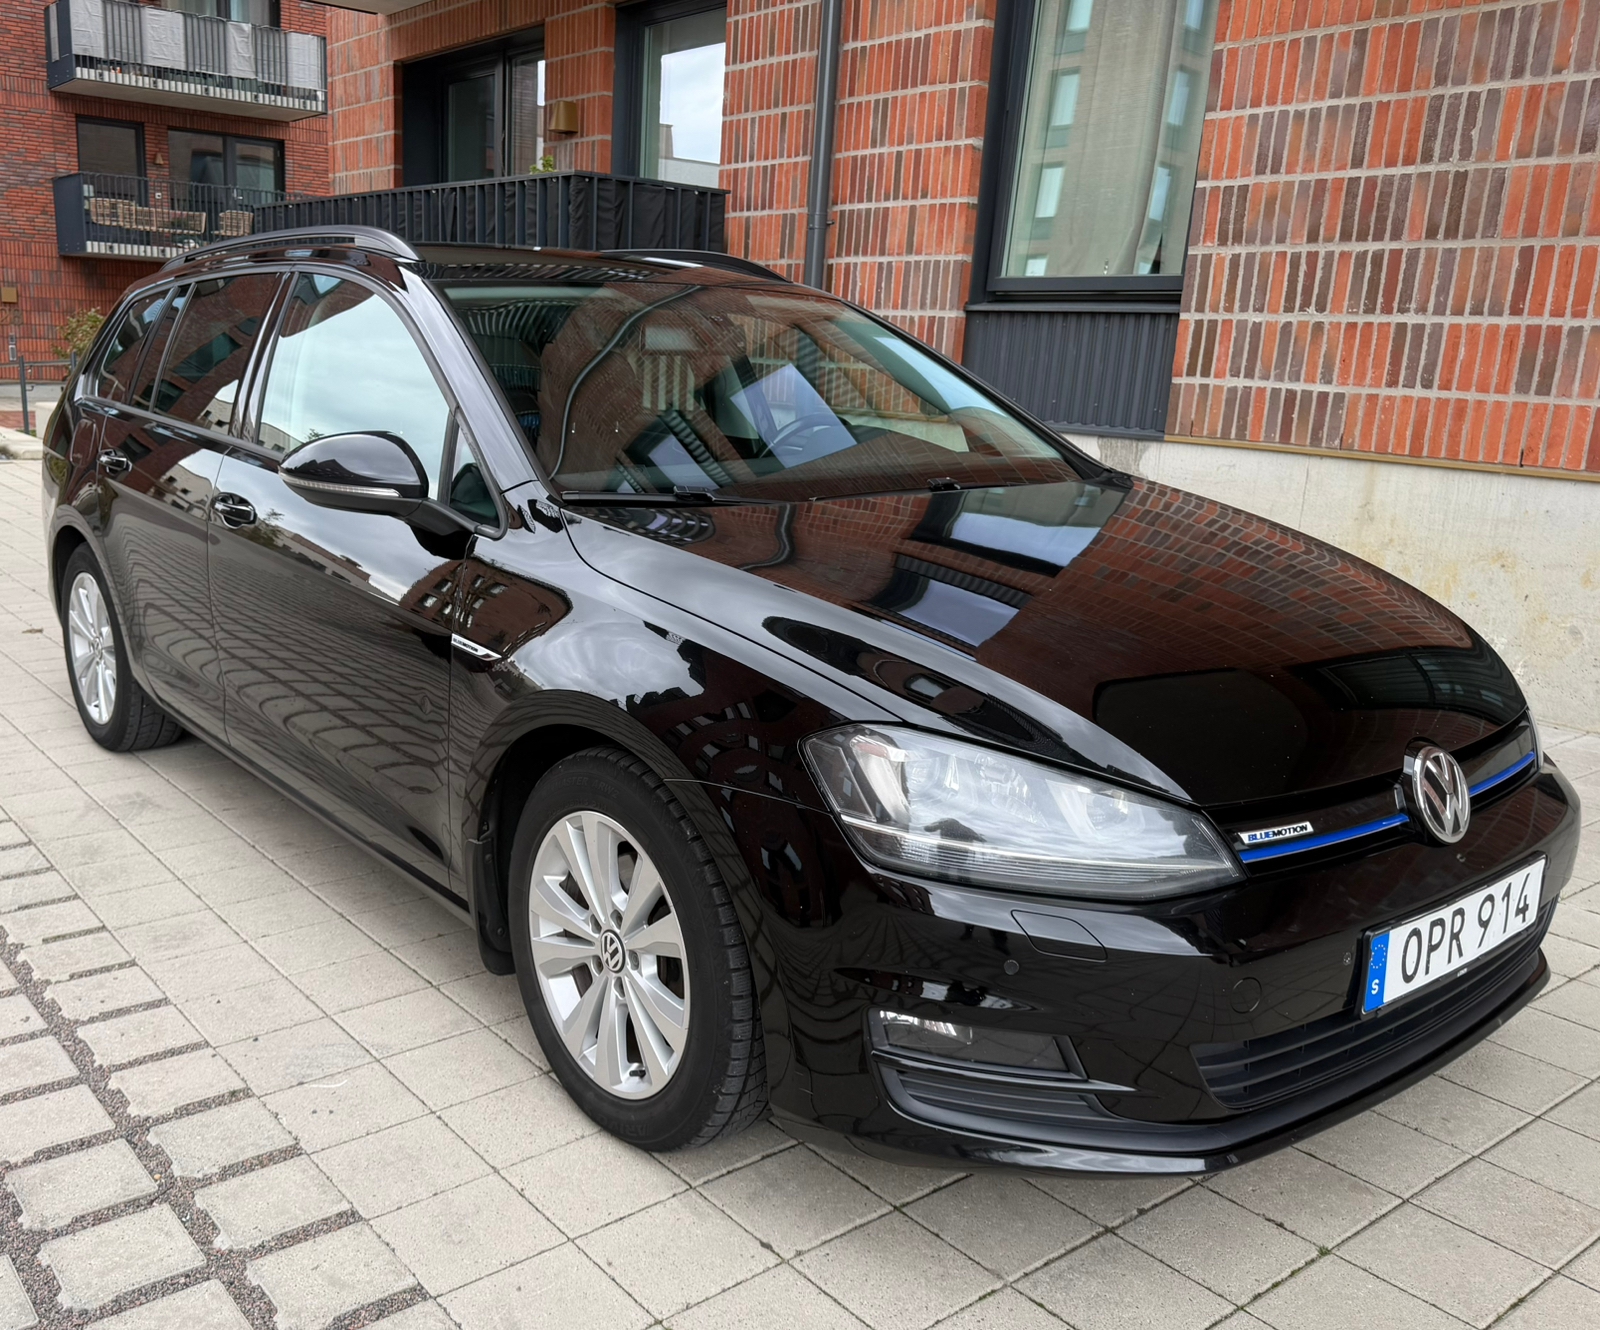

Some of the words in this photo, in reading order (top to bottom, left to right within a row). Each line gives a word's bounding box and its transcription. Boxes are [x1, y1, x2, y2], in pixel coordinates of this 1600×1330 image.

[1247, 824, 1308, 842] BLUEMOTION
[1401, 907, 1466, 984] OPR
[1477, 873, 1531, 949] 914
[1371, 979, 1380, 995] S
